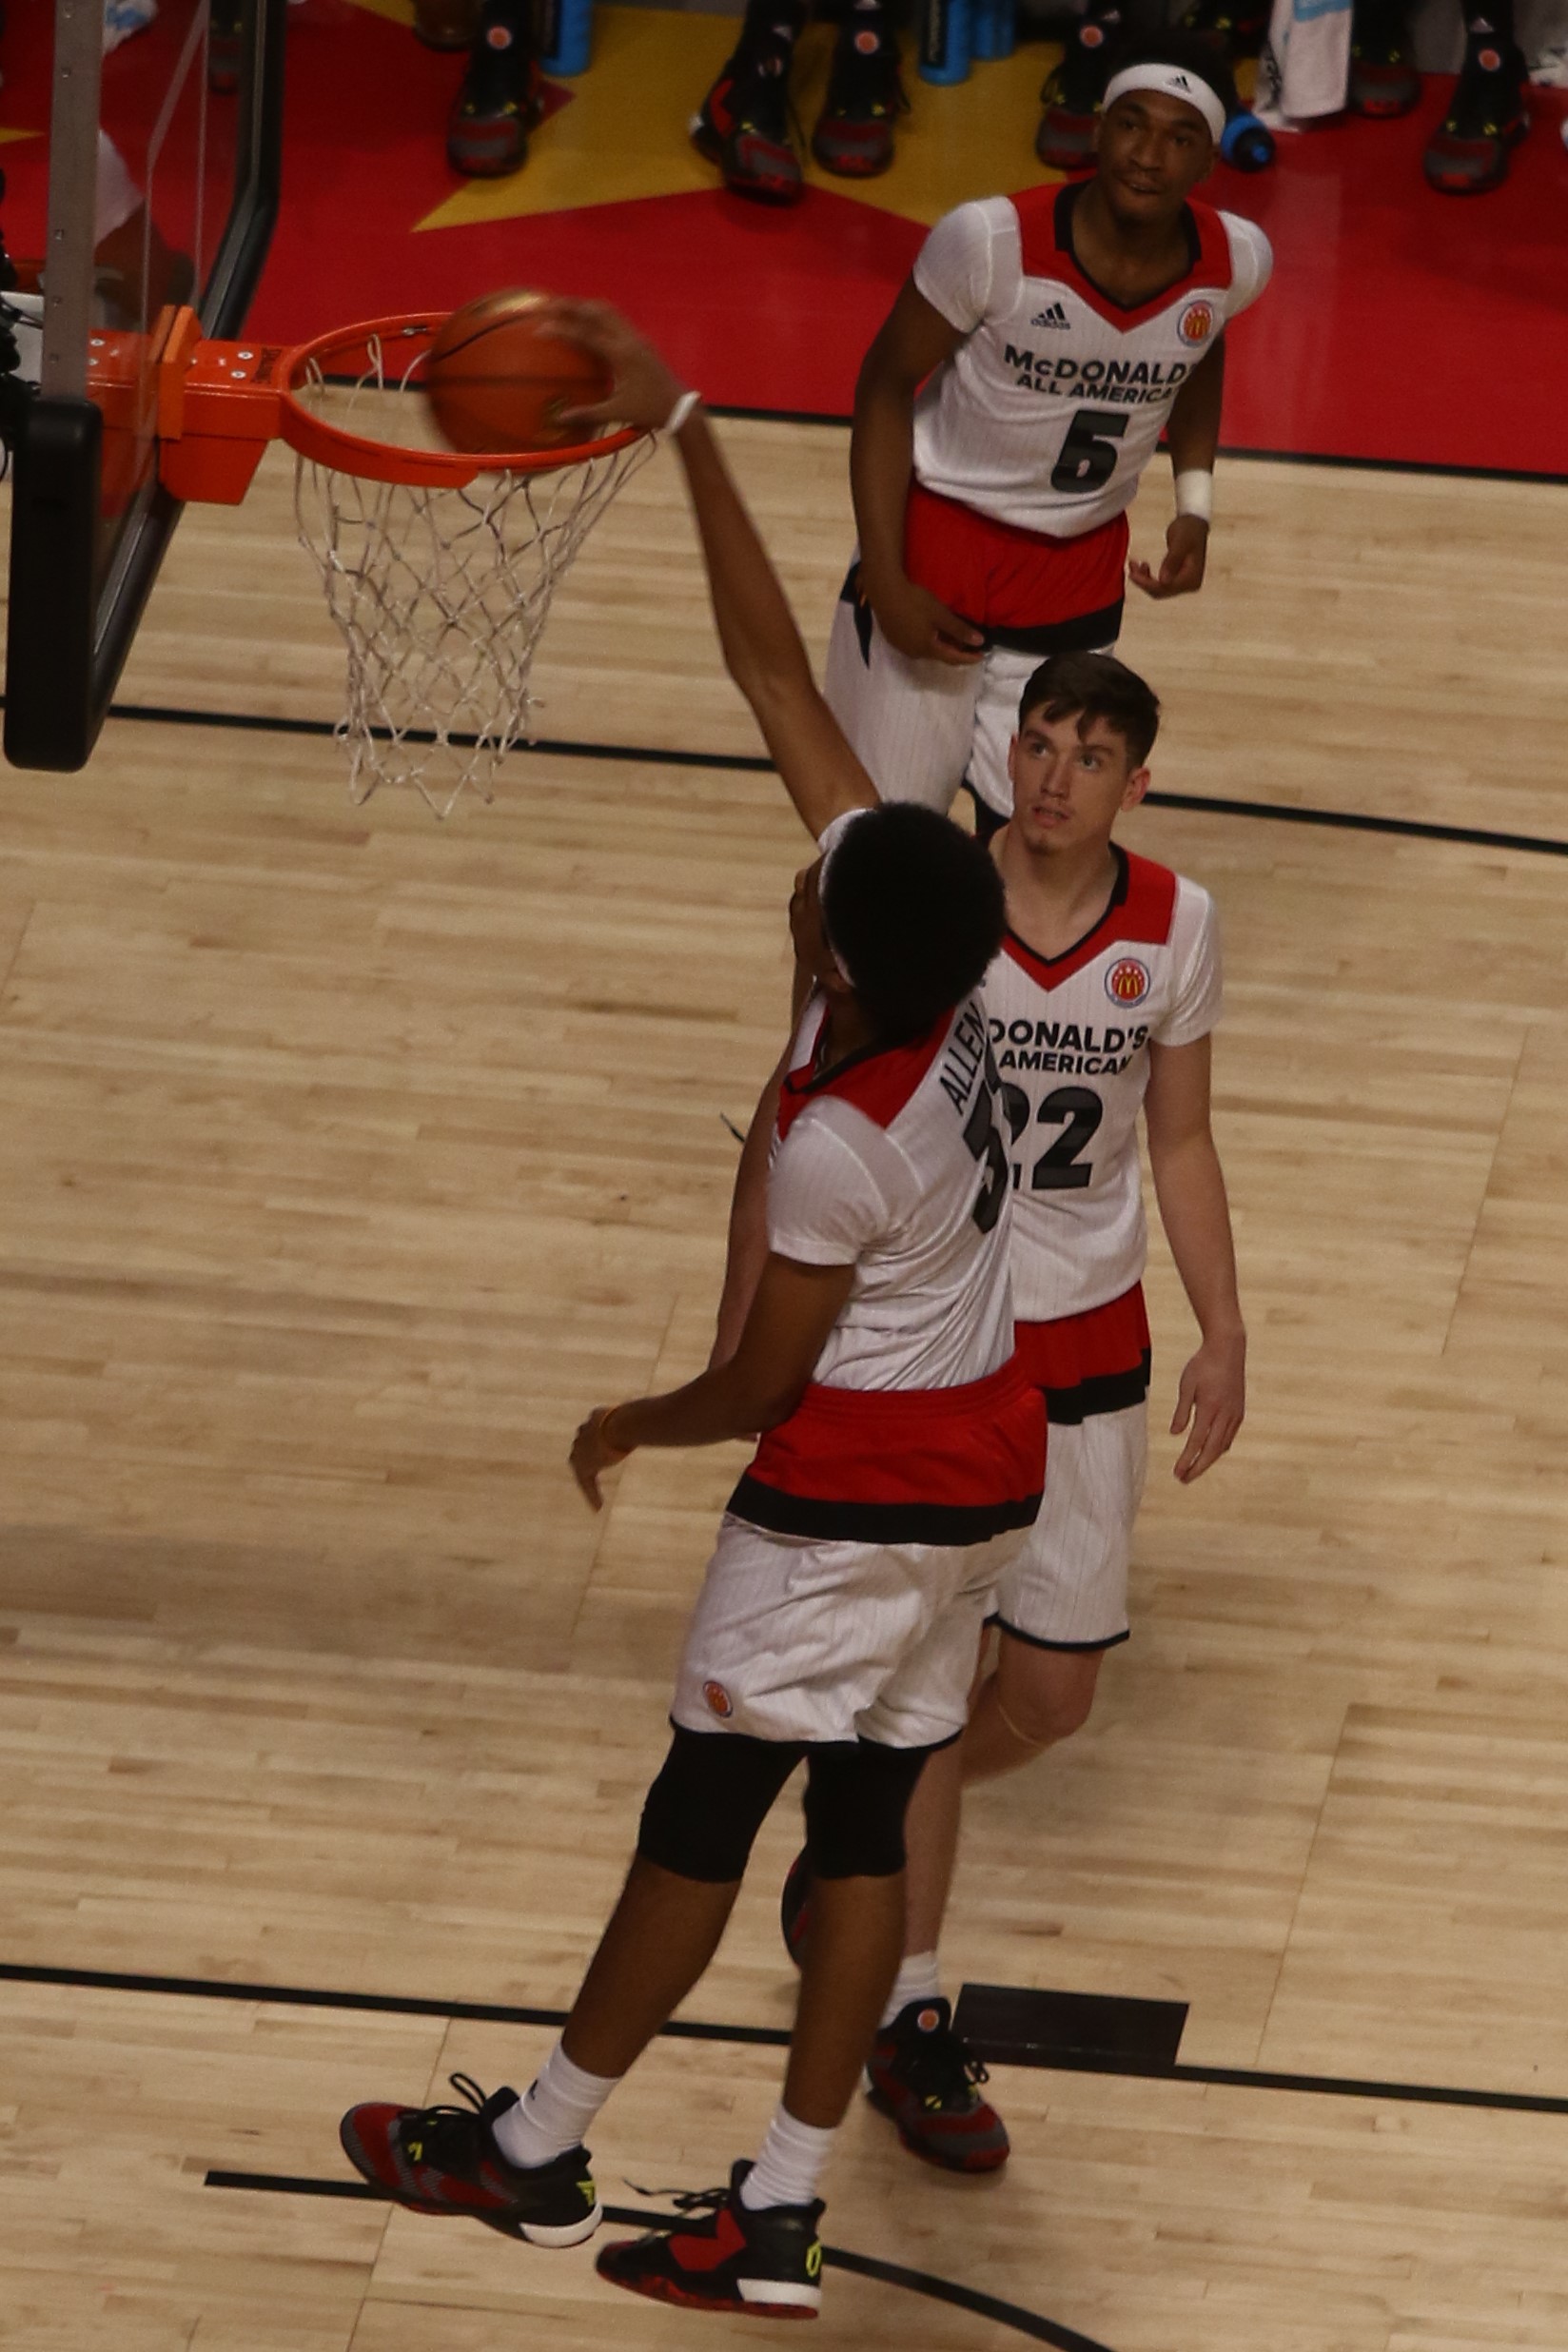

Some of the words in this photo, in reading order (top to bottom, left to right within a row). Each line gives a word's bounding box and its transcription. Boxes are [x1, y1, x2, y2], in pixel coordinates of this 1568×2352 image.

[1016, 374, 1062, 397] ALL
[1050, 409, 1130, 493] 6
[939, 999, 985, 1116] ALLEN
